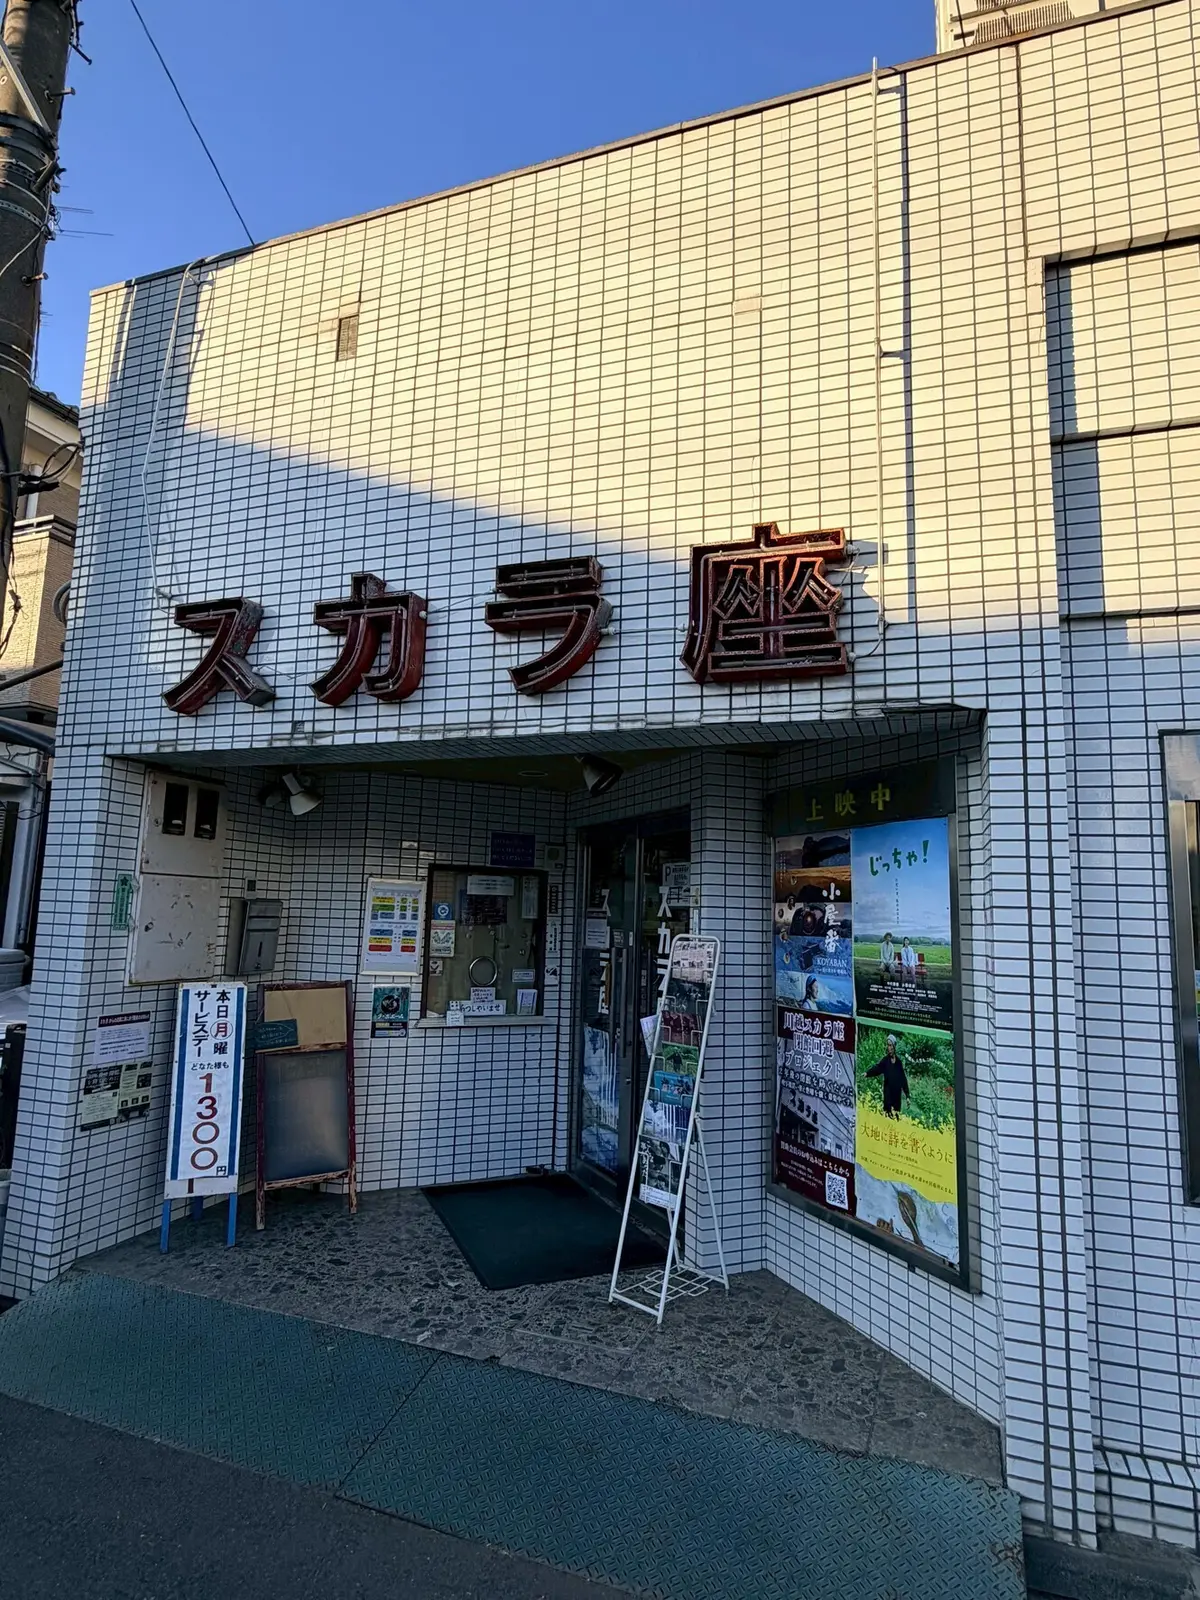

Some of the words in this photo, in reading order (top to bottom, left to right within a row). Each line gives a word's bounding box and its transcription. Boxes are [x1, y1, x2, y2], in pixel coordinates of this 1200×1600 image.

[161, 522, 850, 716] スカラ座
[805, 783, 891, 822] 上映中
[822, 882, 842, 953] 小屋番
[816, 957, 848, 969] KOYABAN
[193, 990, 210, 1058] サービスデー
[211, 990, 232, 1056] 本日月曜
[783, 1011, 845, 1042] 川越スカラ座
[785, 1050, 842, 1080] プロジェクト
[793, 1031, 835, 1060] 閉館回避
[190, 1061, 229, 1071] どなた様も
[860, 1121, 954, 1165] 大地に詩を書くように
